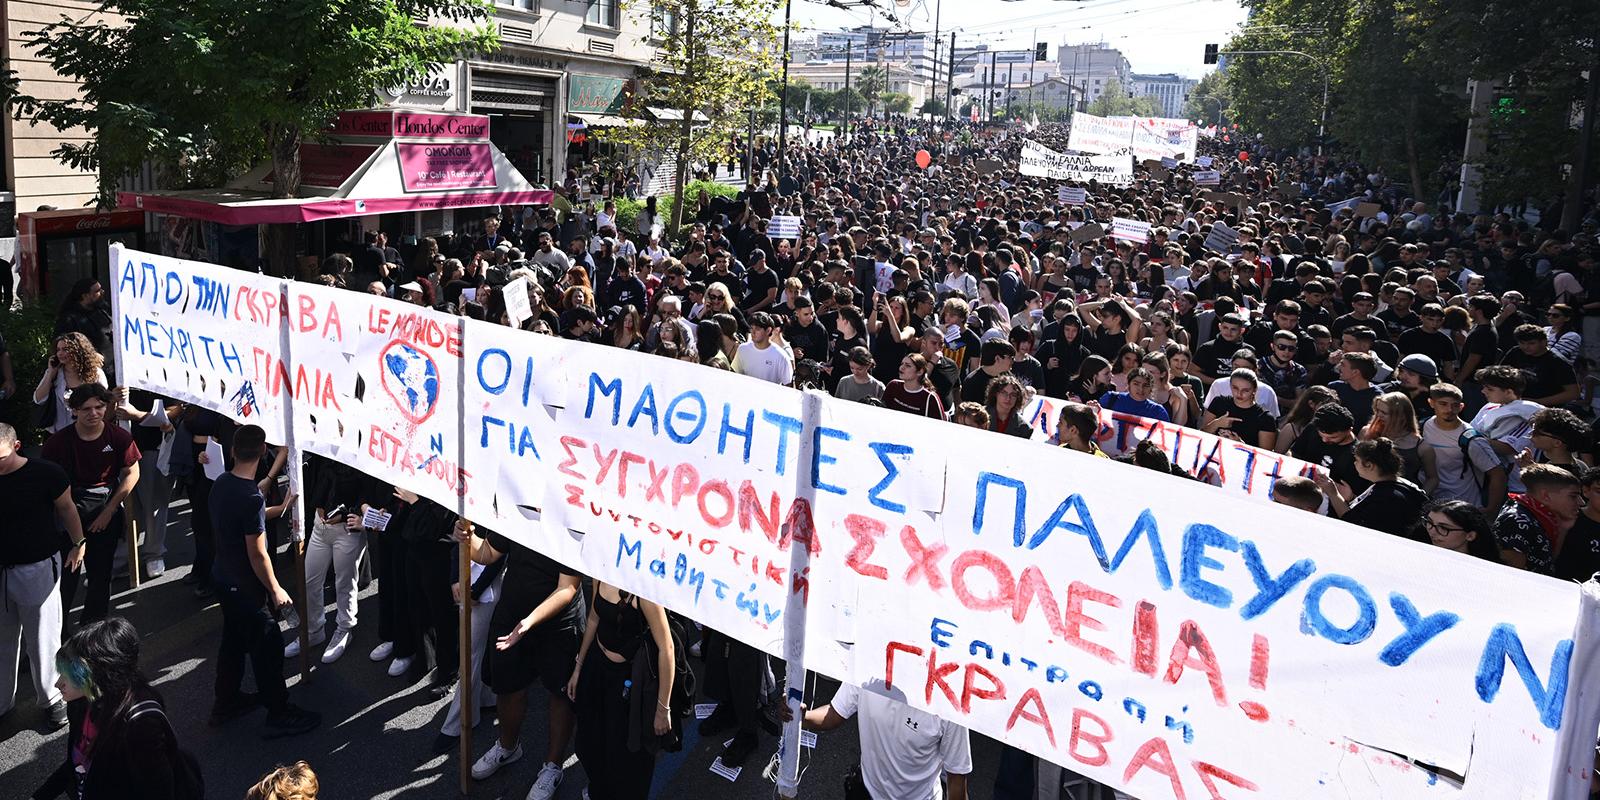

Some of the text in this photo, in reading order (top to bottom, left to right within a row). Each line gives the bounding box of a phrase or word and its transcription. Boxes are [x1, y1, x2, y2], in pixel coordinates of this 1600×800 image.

[410, 88, 430, 96] COFFEE
[397, 116, 486, 136] Hondos Center
[425, 147, 472, 157] OMONOIA
[1059, 155, 1092, 166] ΓΑΛΛΙΑ
[450, 169, 486, 178] Restaurant
[1047, 169, 1083, 180] ΠΑΙΔΕΙΑ
[1066, 164, 1080, 172] ΓΙΑ
[1082, 165, 1116, 174] ΔΩΡΕΑΝ
[76, 216, 112, 230] Coca-Cola
[120, 260, 343, 343] ΑΠΟ ΤΗΝ ΓΚΡΑΒΑ
[368, 304, 464, 359] LE MONDE
[123, 314, 198, 369] ΜΕΧΡΙ
[198, 335, 244, 377] ΤΗ
[476, 347, 1575, 731] ΟΙ ΜΑΘΗΤΕΣ ΠΑΛΕΥΟΥΝ
[480, 415, 1270, 723] ΓΙΑ ΣΥΓΧΡΟΝΑ ΣΧΟΛΕΙΑ!
[616, 532, 782, 626] Μαθητών
